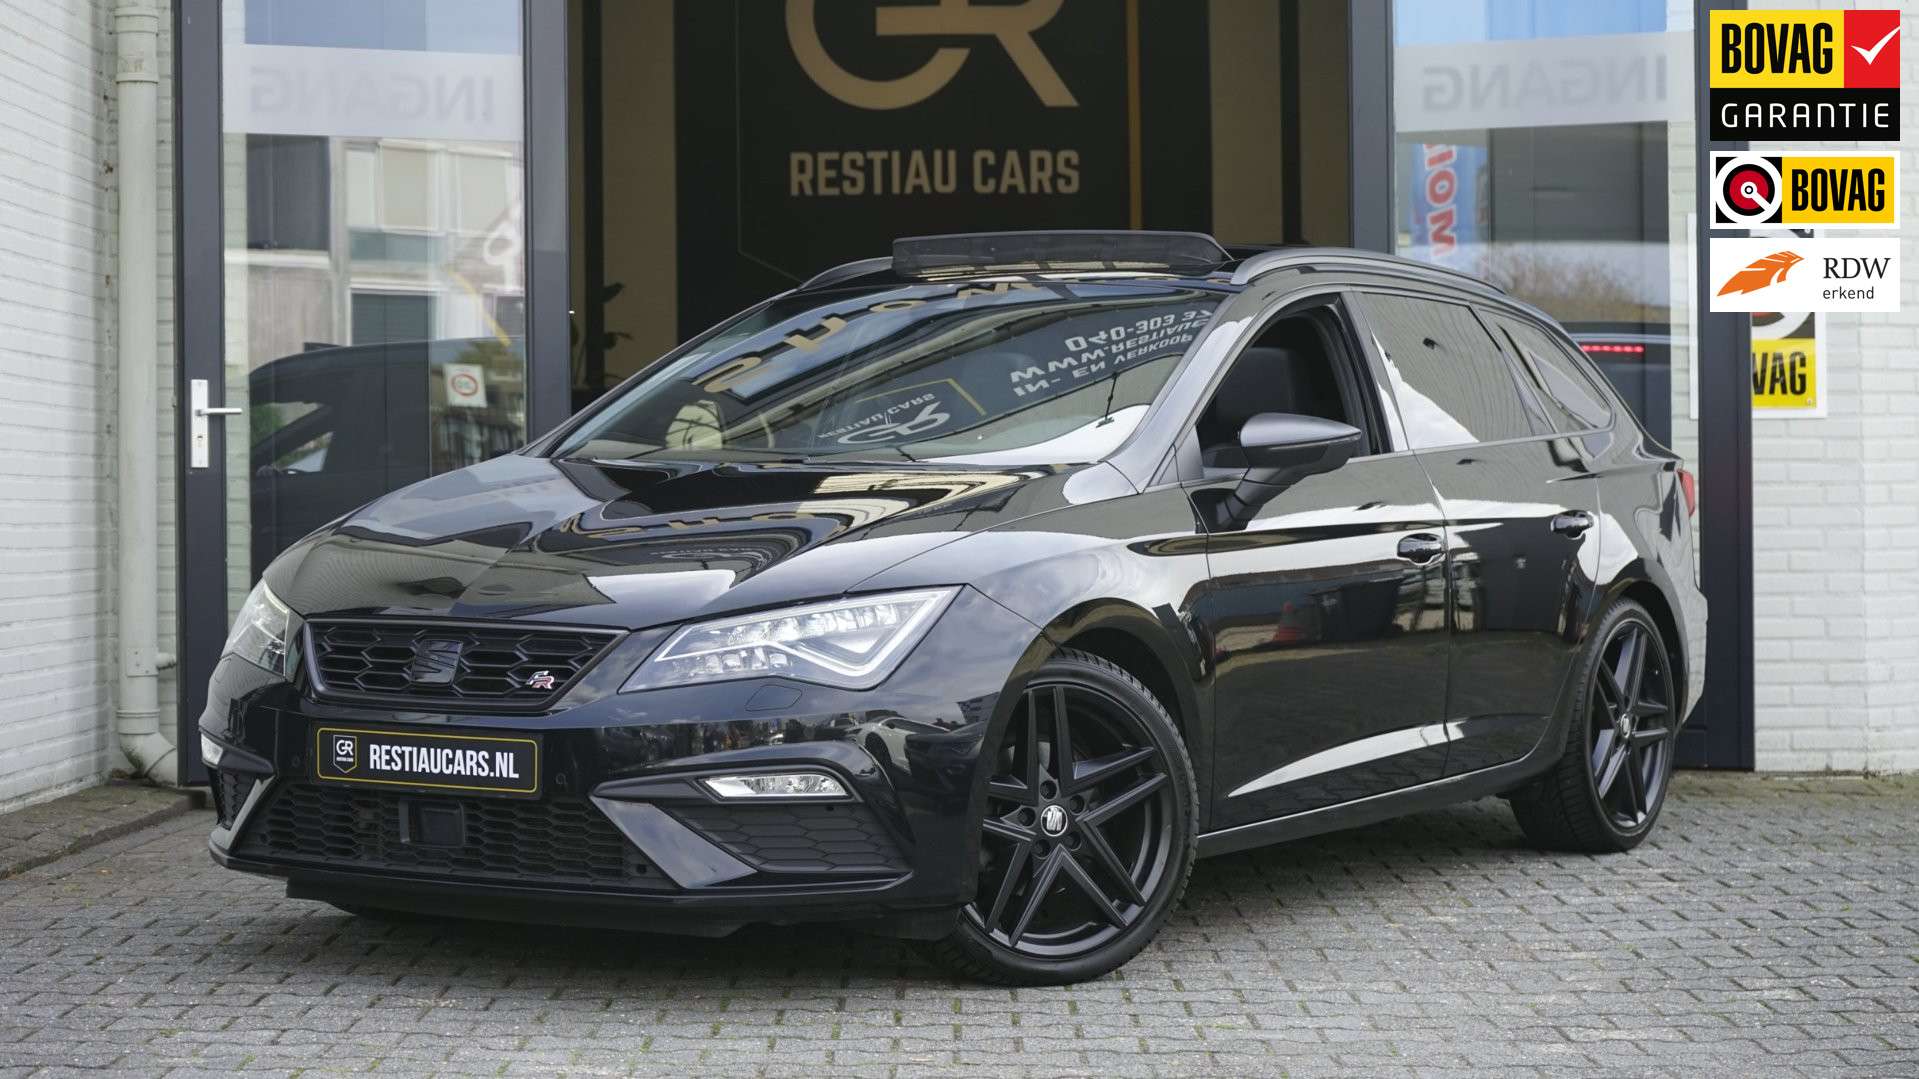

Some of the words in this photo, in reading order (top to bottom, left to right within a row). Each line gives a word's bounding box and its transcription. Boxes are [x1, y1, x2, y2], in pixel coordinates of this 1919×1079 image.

[789, 150, 957, 196] RESTIAU
[973, 149, 1080, 195] CARS
[369, 744, 520, 779] RESTIAUCARS.NL
